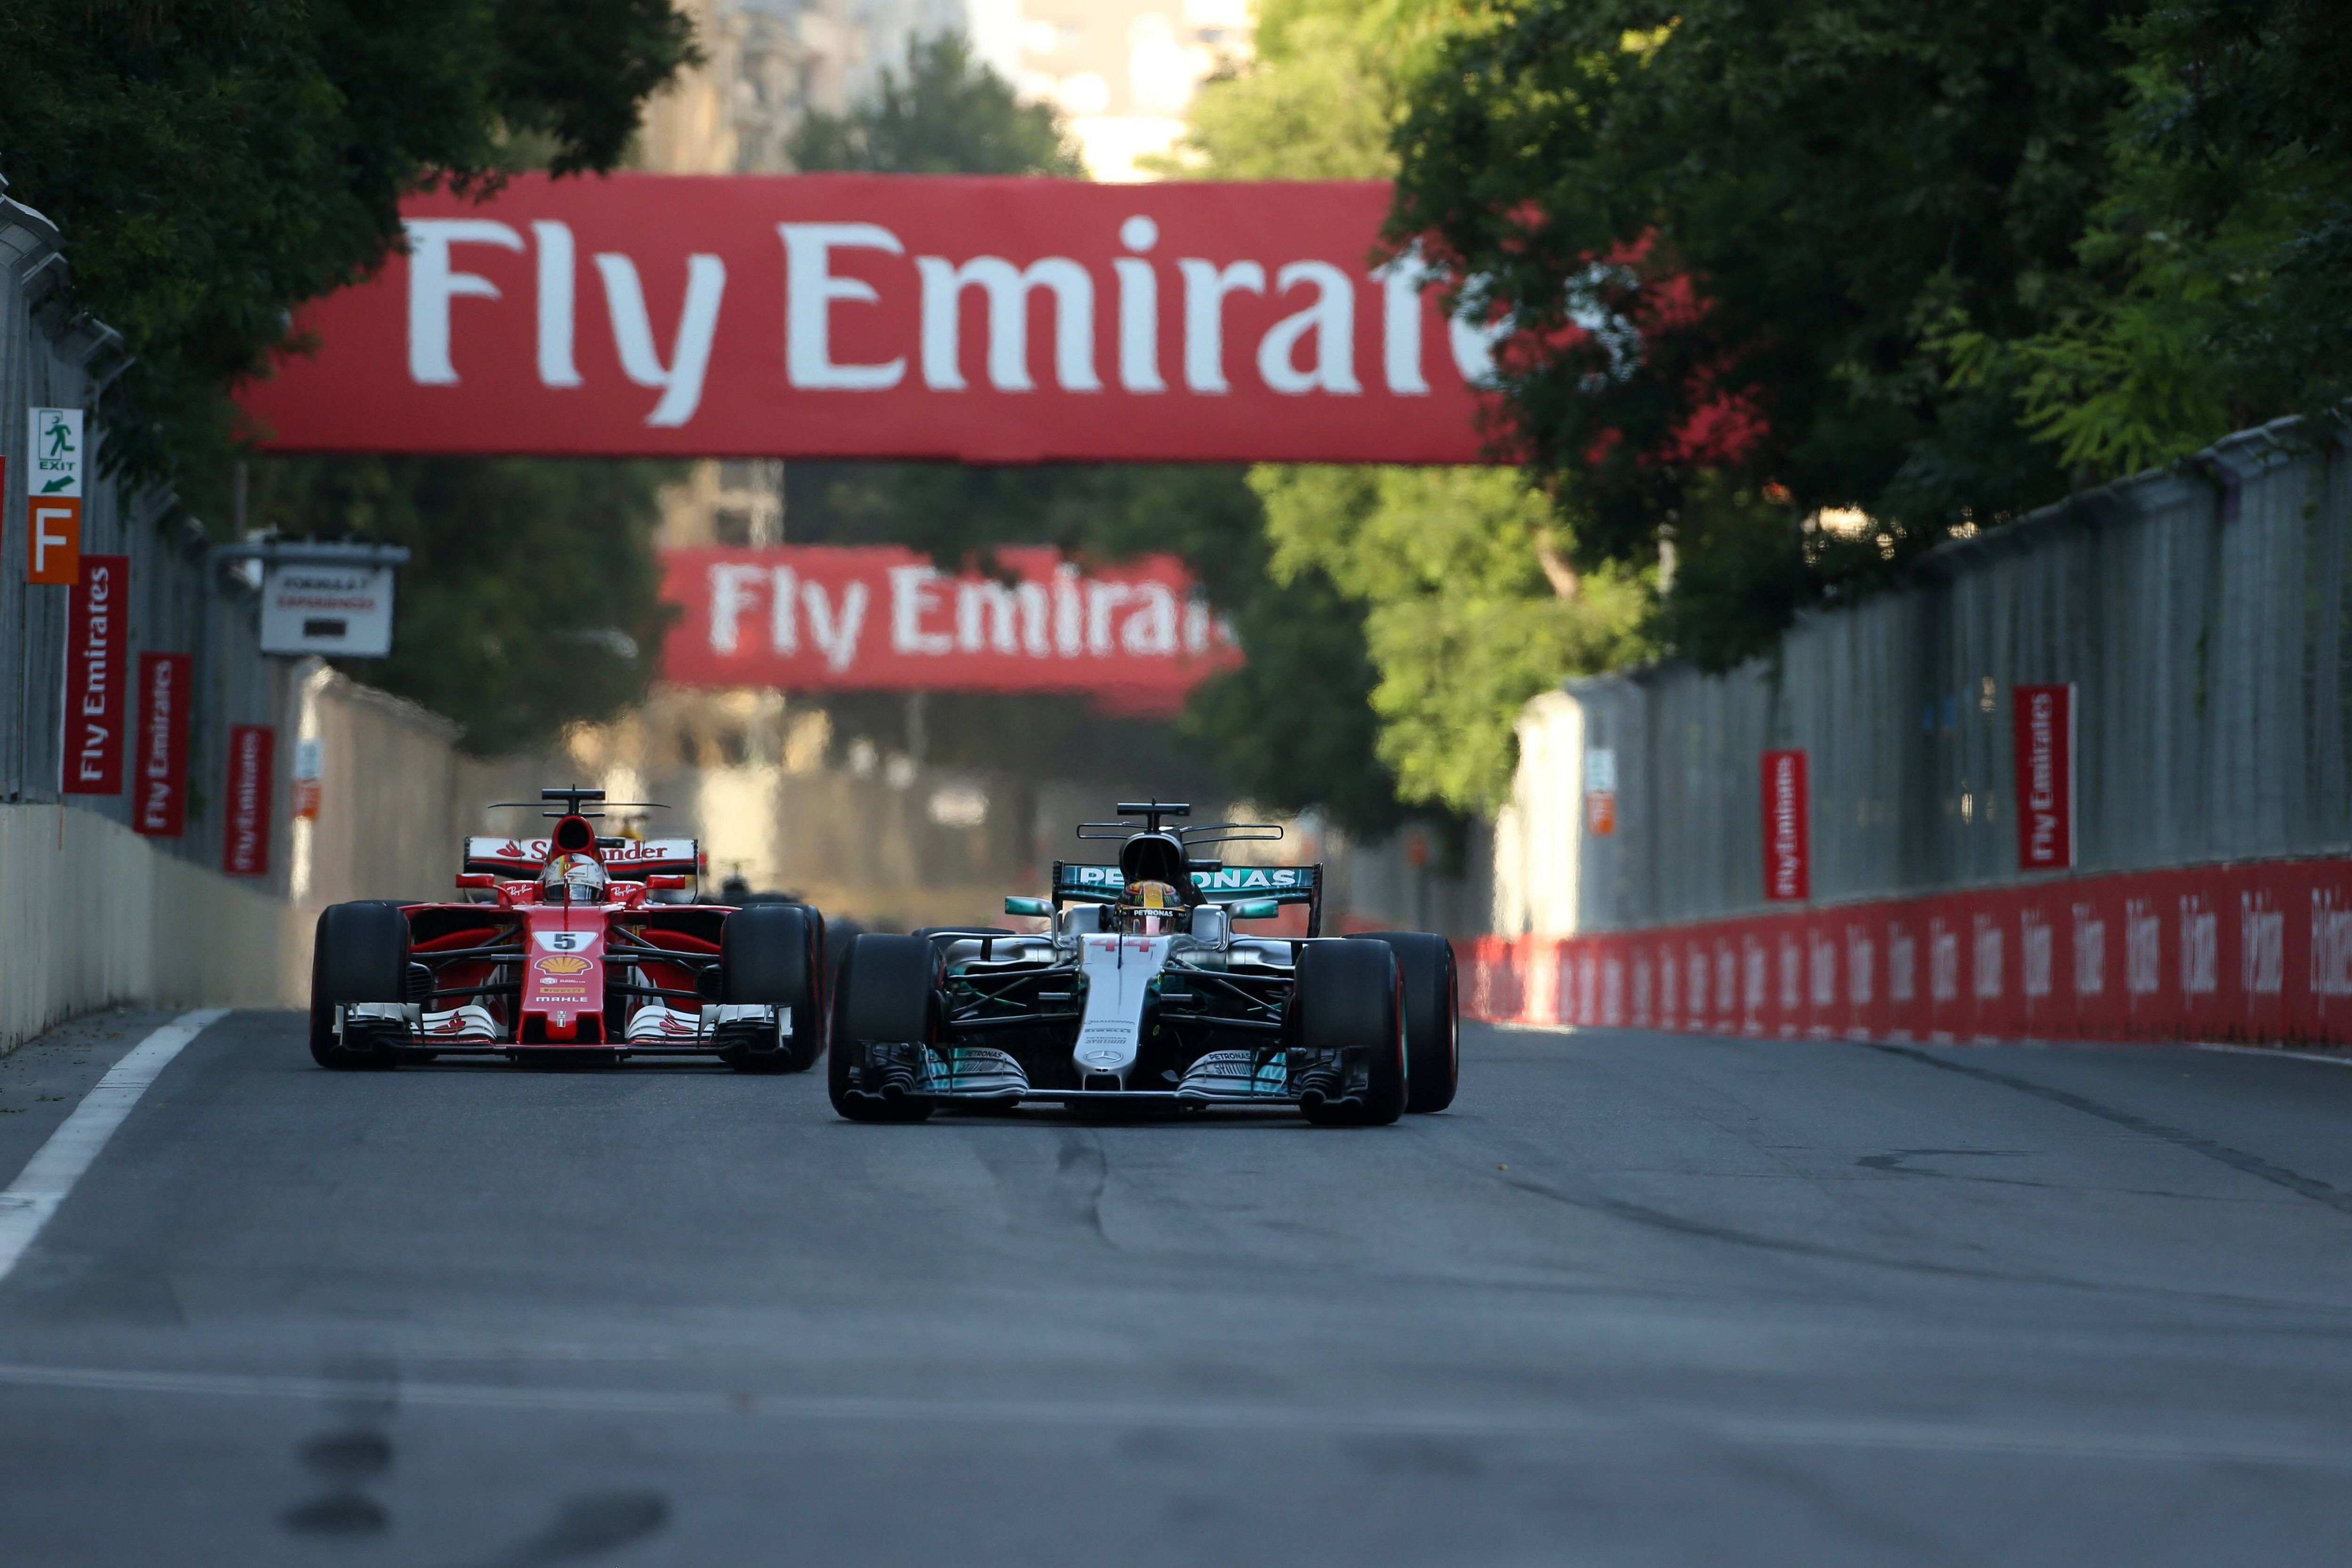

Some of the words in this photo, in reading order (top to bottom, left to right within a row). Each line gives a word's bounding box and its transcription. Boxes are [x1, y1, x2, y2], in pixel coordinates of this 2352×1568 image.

[401, 217, 726, 427] Fly
[40, 462, 75, 470] EXIT
[35, 507, 72, 572] F
[83, 566, 109, 717] Emirates
[709, 562, 869, 673] Fly
[889, 563, 1241, 659] Emira
[80, 724, 110, 781] Fly
[145, 780, 171, 828] Fly
[531, 840, 667, 860] Snder
[2031, 812, 2058, 860] Fly
[1080, 868, 1295, 888] PEONAS
[553, 933, 576, 949] 5
